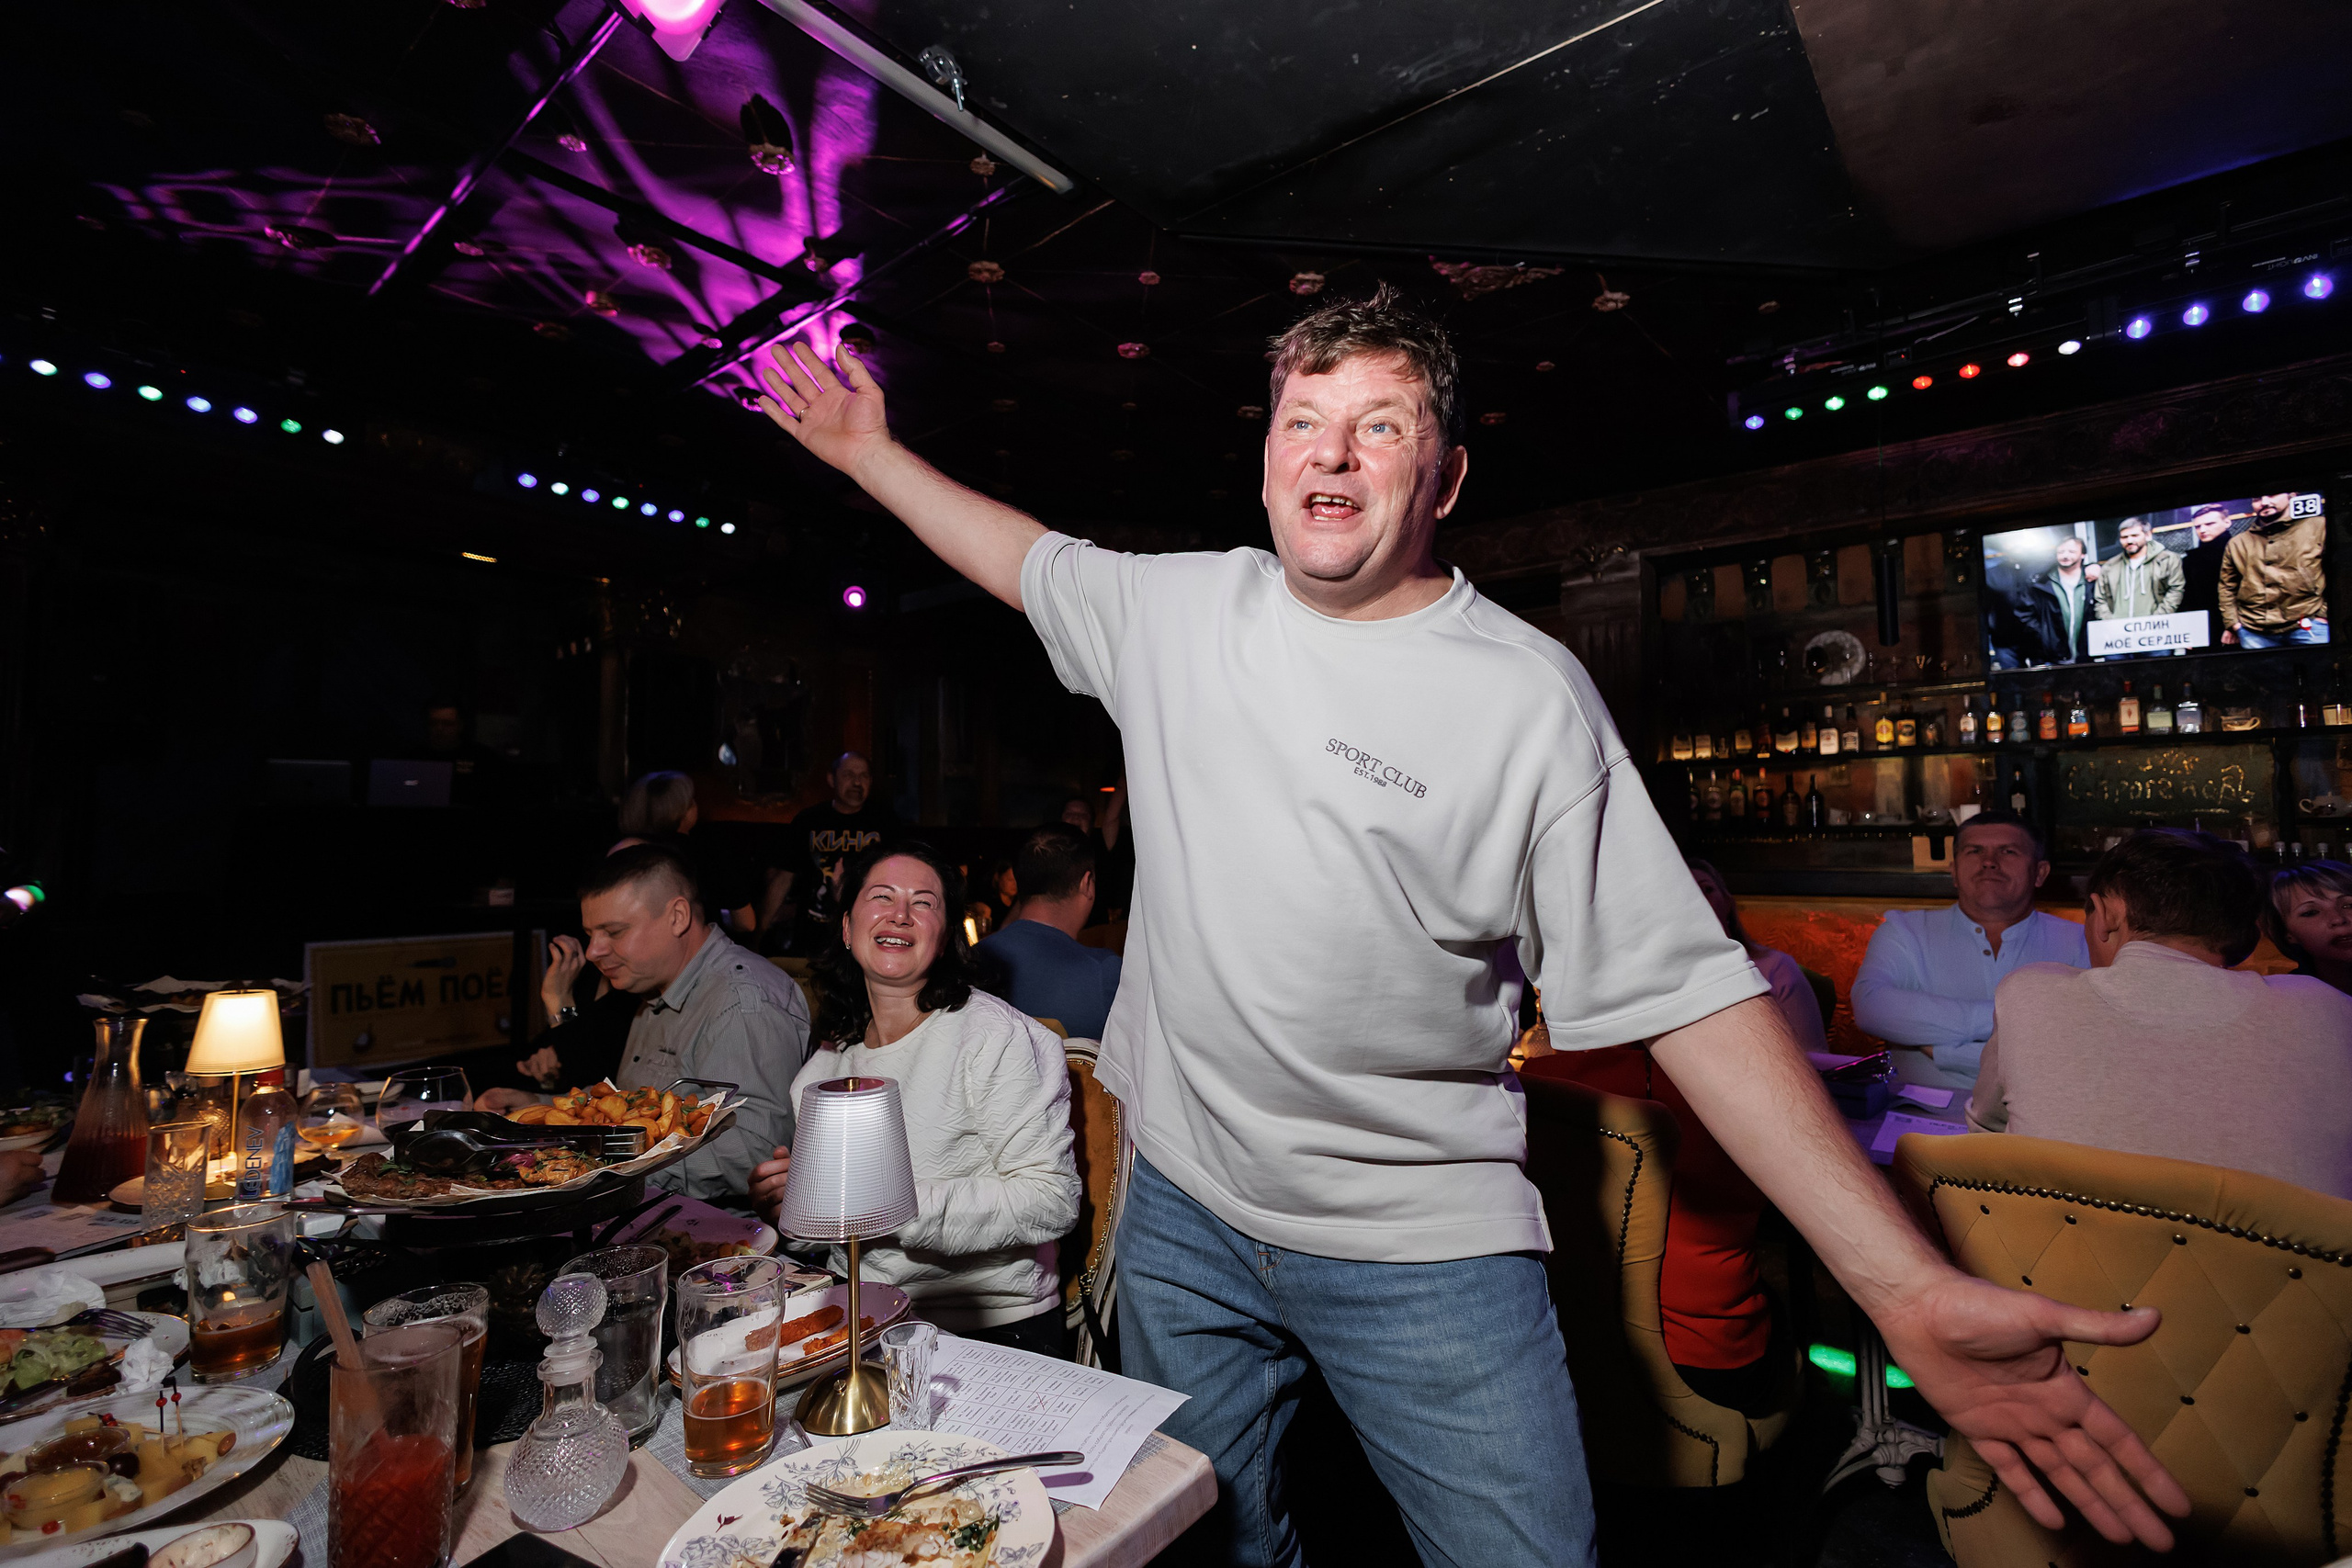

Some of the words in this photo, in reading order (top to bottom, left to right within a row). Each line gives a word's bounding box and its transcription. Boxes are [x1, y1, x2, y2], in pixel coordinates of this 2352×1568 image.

[2293, 499, 2317, 514] 38
[2123, 619, 2169, 633] СПЛИН
[2138, 633, 2191, 647] СЕРДЦЕ
[1325, 738, 1383, 773] SPORT
[1382, 766, 1428, 798] CLUB
[331, 975, 424, 1014] ПЬЁМ
[241, 1125, 265, 1200] LEDENEV
